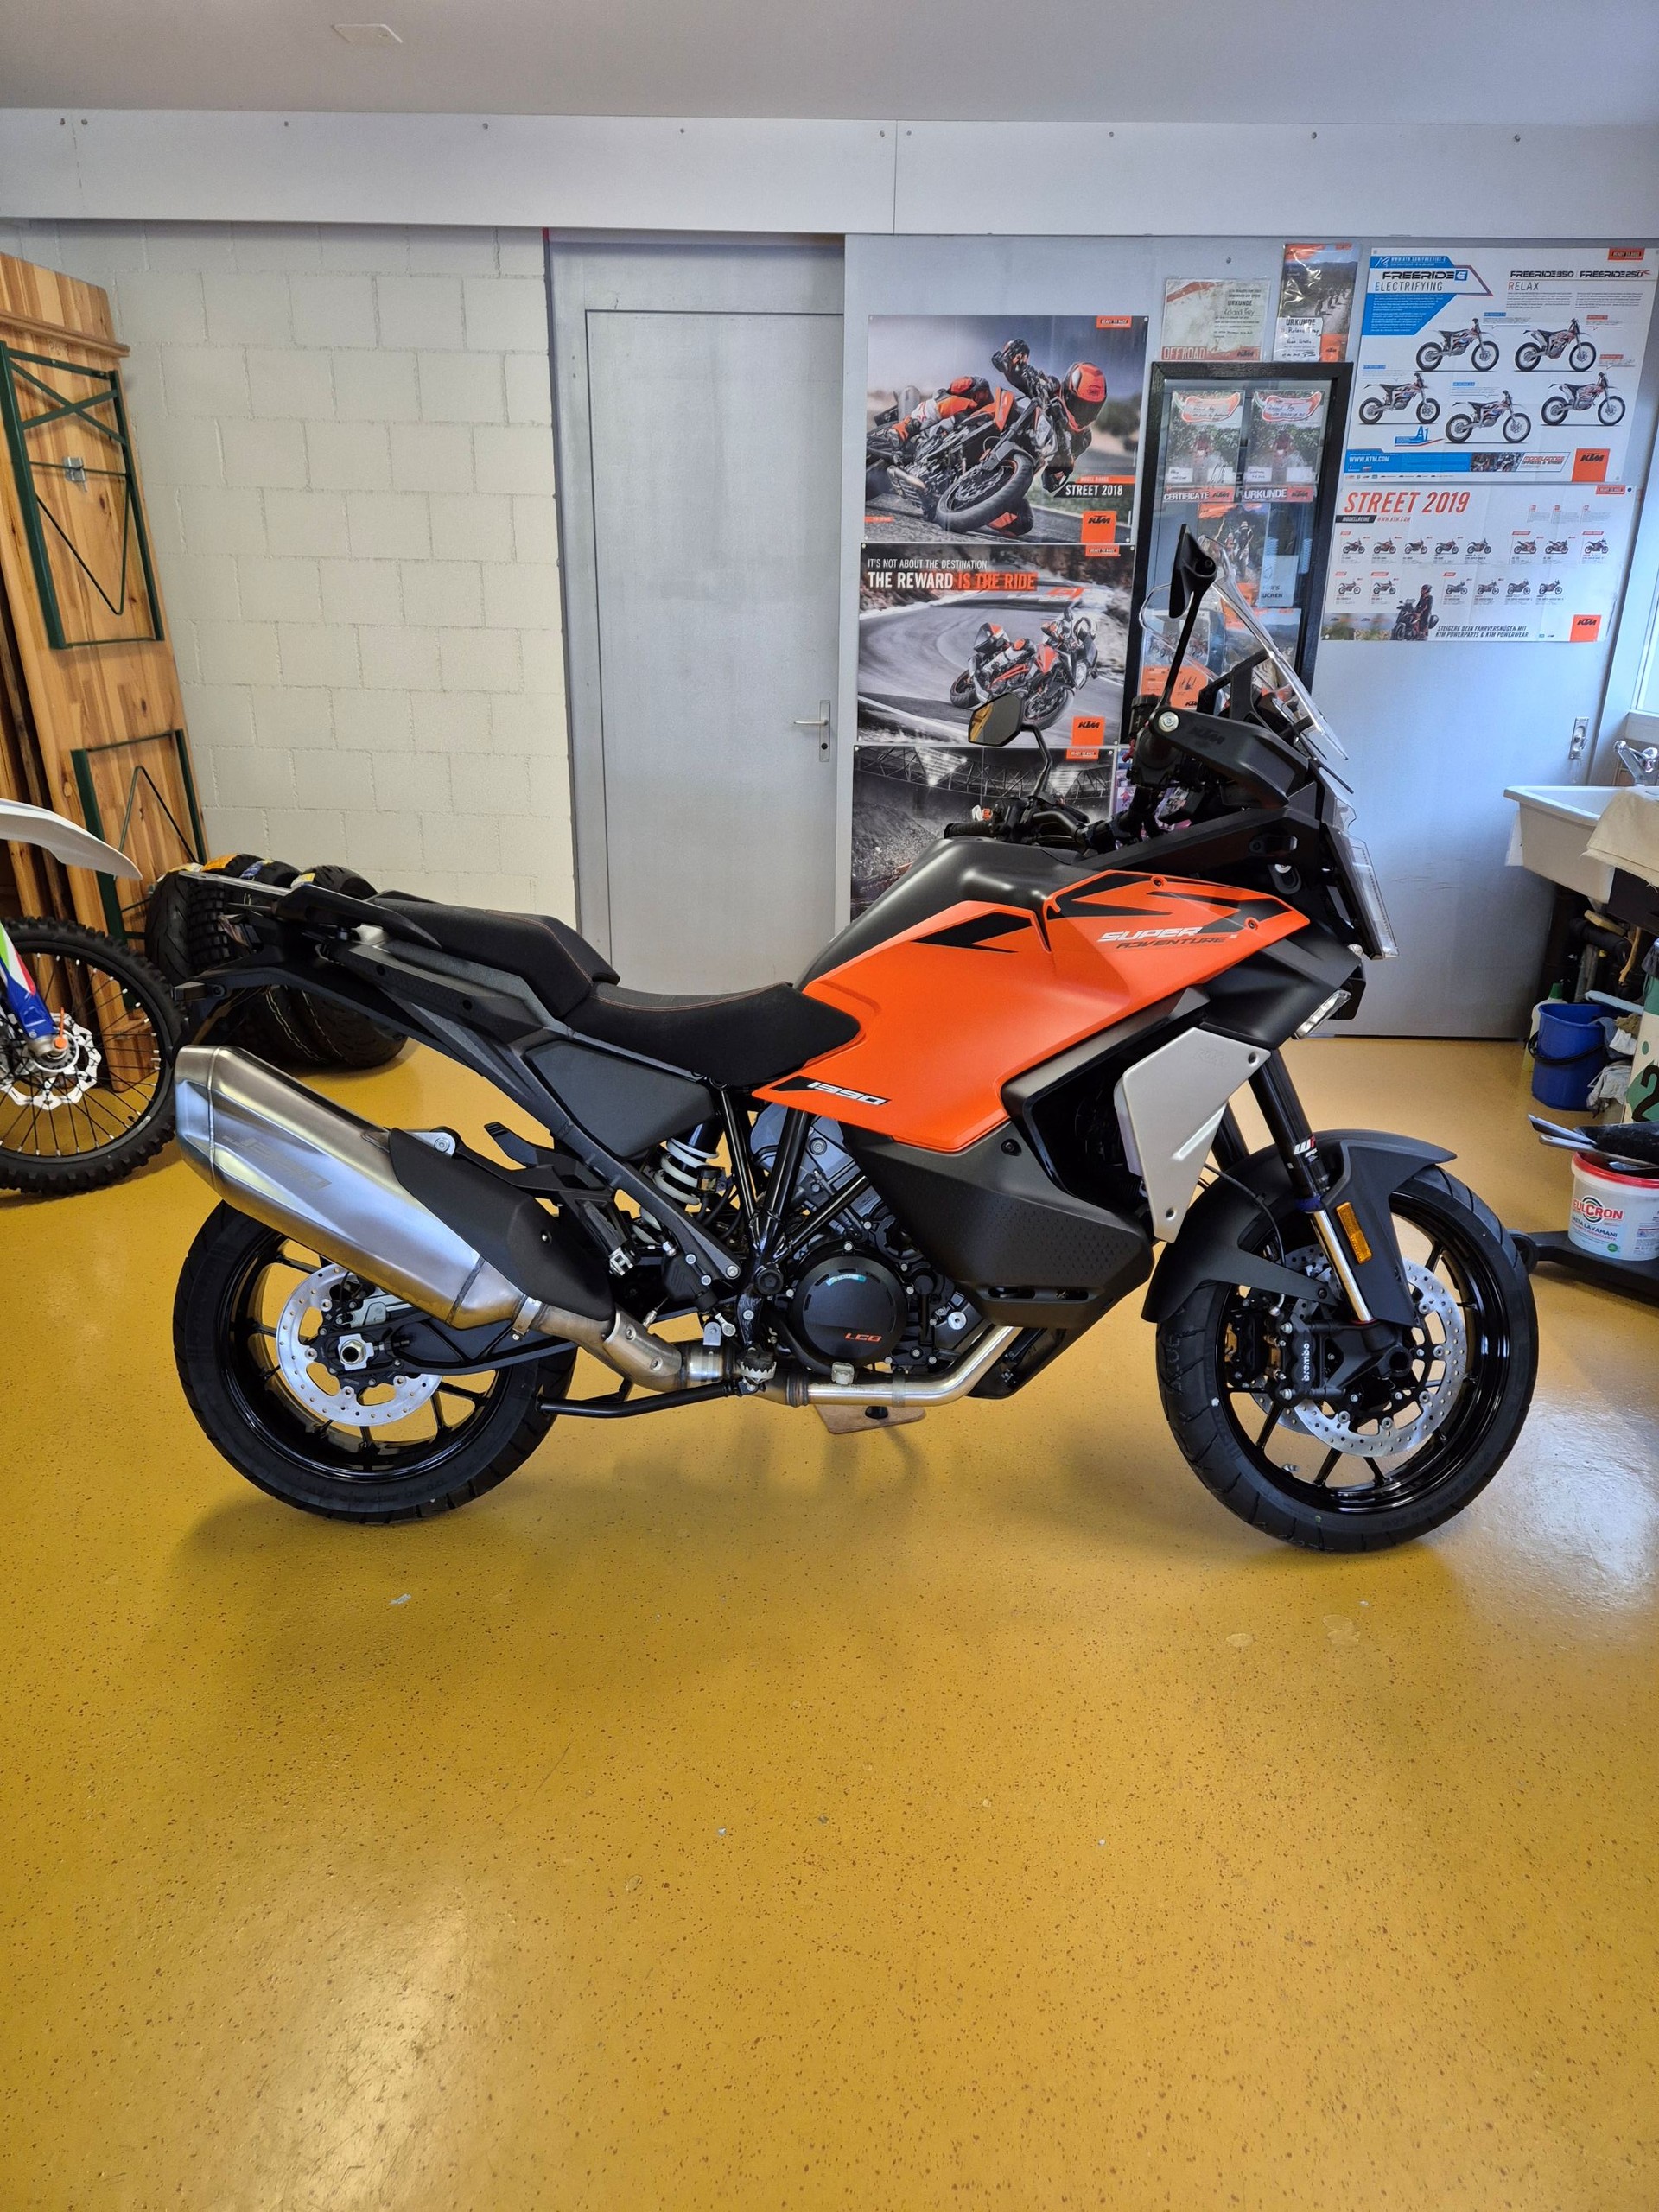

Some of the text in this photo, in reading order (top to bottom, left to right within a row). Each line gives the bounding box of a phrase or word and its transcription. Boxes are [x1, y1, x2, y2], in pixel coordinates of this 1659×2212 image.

[1382, 271, 1454, 280] FREERIDE
[1375, 282, 1443, 292] ELECTRIFYING
[1508, 282, 1540, 290] RELAX
[1580, 453, 1605, 461] KTM
[1065, 485, 1123, 496] STREET 2018
[1244, 489, 1287, 499] URKUNDE
[1163, 492, 1210, 501] CERTIFICATE
[1344, 491, 1471, 513] STREET 2019
[1088, 515, 1111, 524] KTM
[868, 558, 988, 569] IT'S NOT ABOUT THE DESTINATION
[868, 572, 1036, 589] THE REWARD IS THE RIDE
[1096, 926, 1203, 942] SUPER
[1116, 937, 1228, 949] ADVENTURE
[1584, 1224, 1618, 1238] LAVAMANI
[845, 1332, 882, 1342] LC8
[1301, 1343, 1310, 1382] brembo
